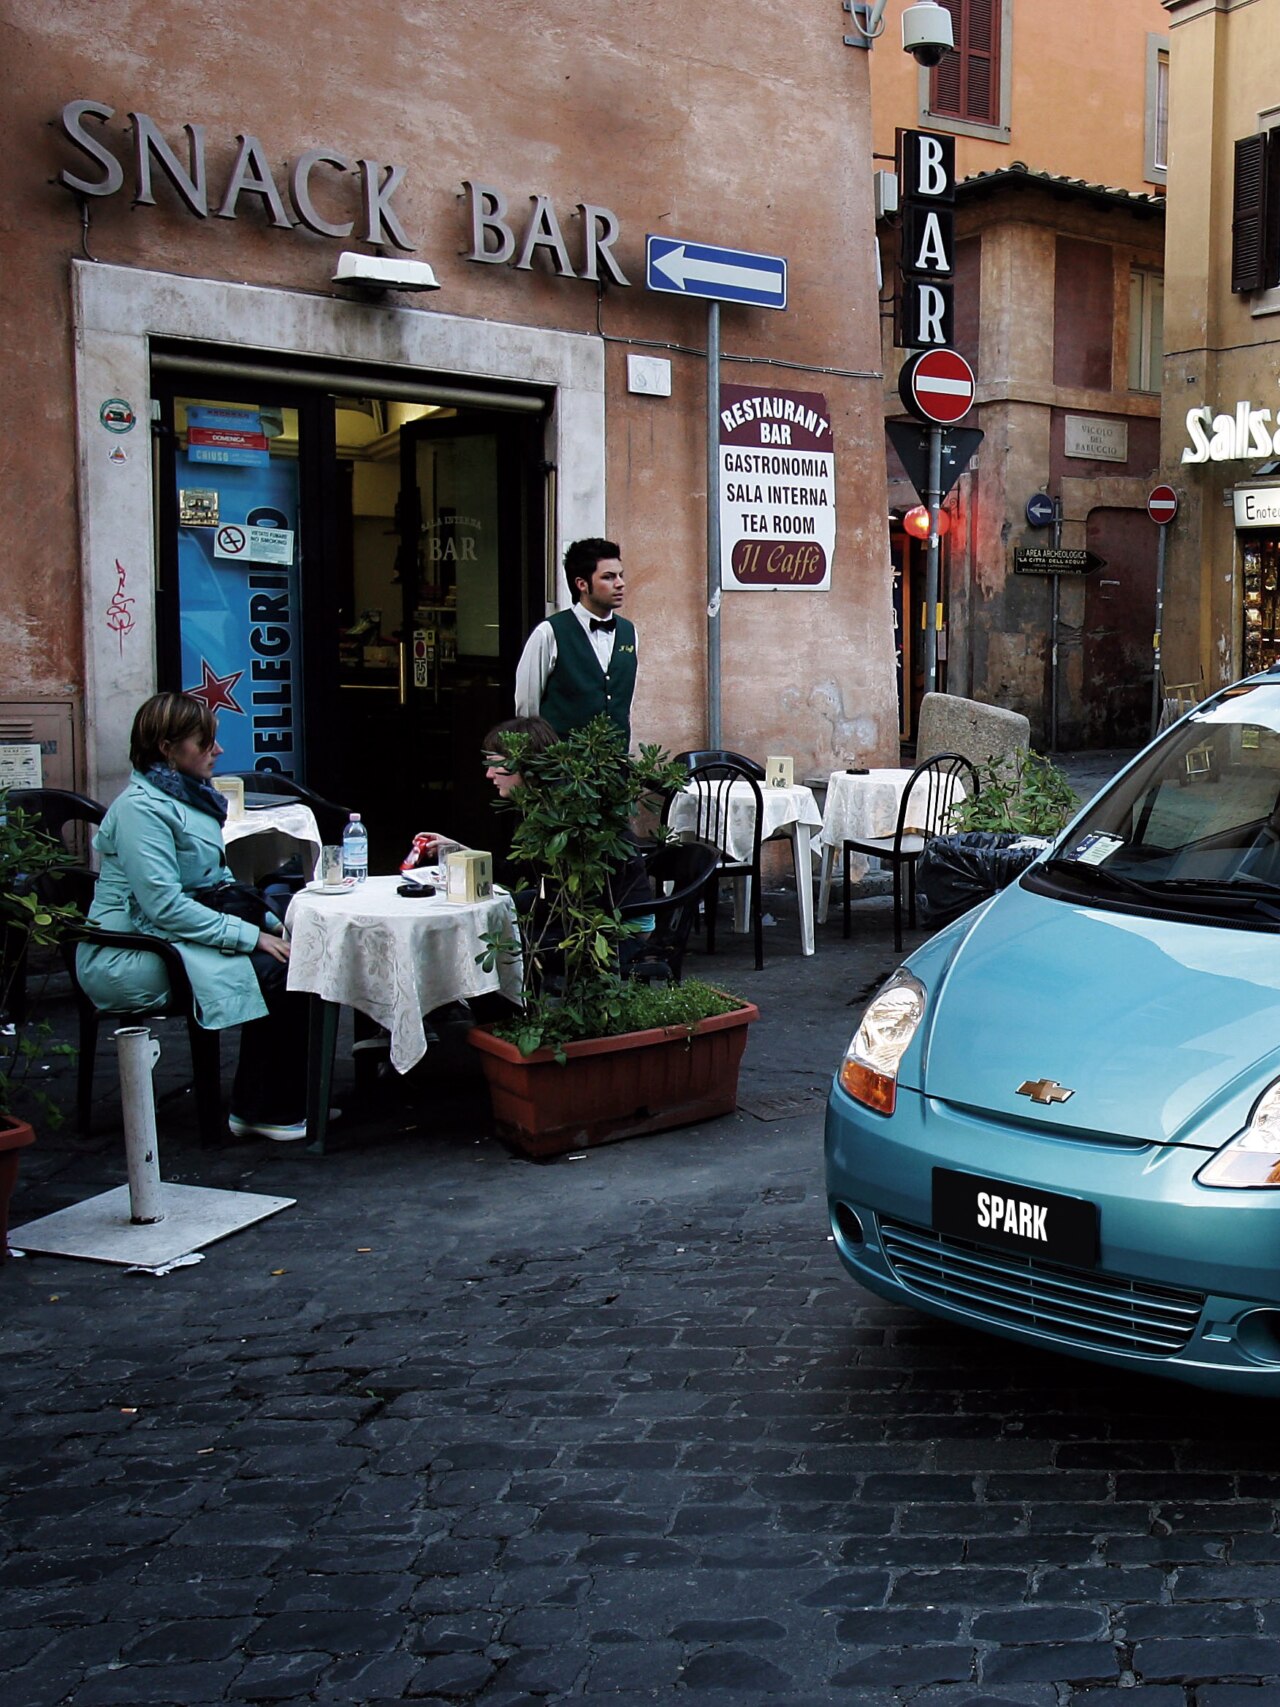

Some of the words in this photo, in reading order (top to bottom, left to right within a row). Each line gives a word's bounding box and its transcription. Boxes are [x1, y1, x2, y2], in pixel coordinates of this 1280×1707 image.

[60, 101, 418, 251] SNACK
[460, 180, 632, 287] BAR
[915, 137, 950, 345] BAR
[720, 396, 829, 438] RESTAURANT
[212, 434, 245, 443] DOMENICA
[760, 422, 792, 445] BAR
[1081, 424, 1112, 437] VICOLO
[1090, 435, 1104, 444] DEL
[195, 450, 229, 462] CHIUSO
[724, 453, 829, 478] GASTRONOMIA
[726, 483, 763, 504] SALA
[768, 485, 828, 506] INTERNA
[741, 514, 768, 533] TEA
[773, 515, 815, 535] ROOM
[429, 537, 478, 561] BAR
[1025, 549, 1042, 557] AREA
[1042, 550, 1087, 559] ARCHEOLOGICA
[738, 543, 763, 576] Il
[767, 544, 820, 581] Caffè
[246, 506, 295, 781] PELLEGRIO
[977, 1192, 1048, 1242] SPARK
